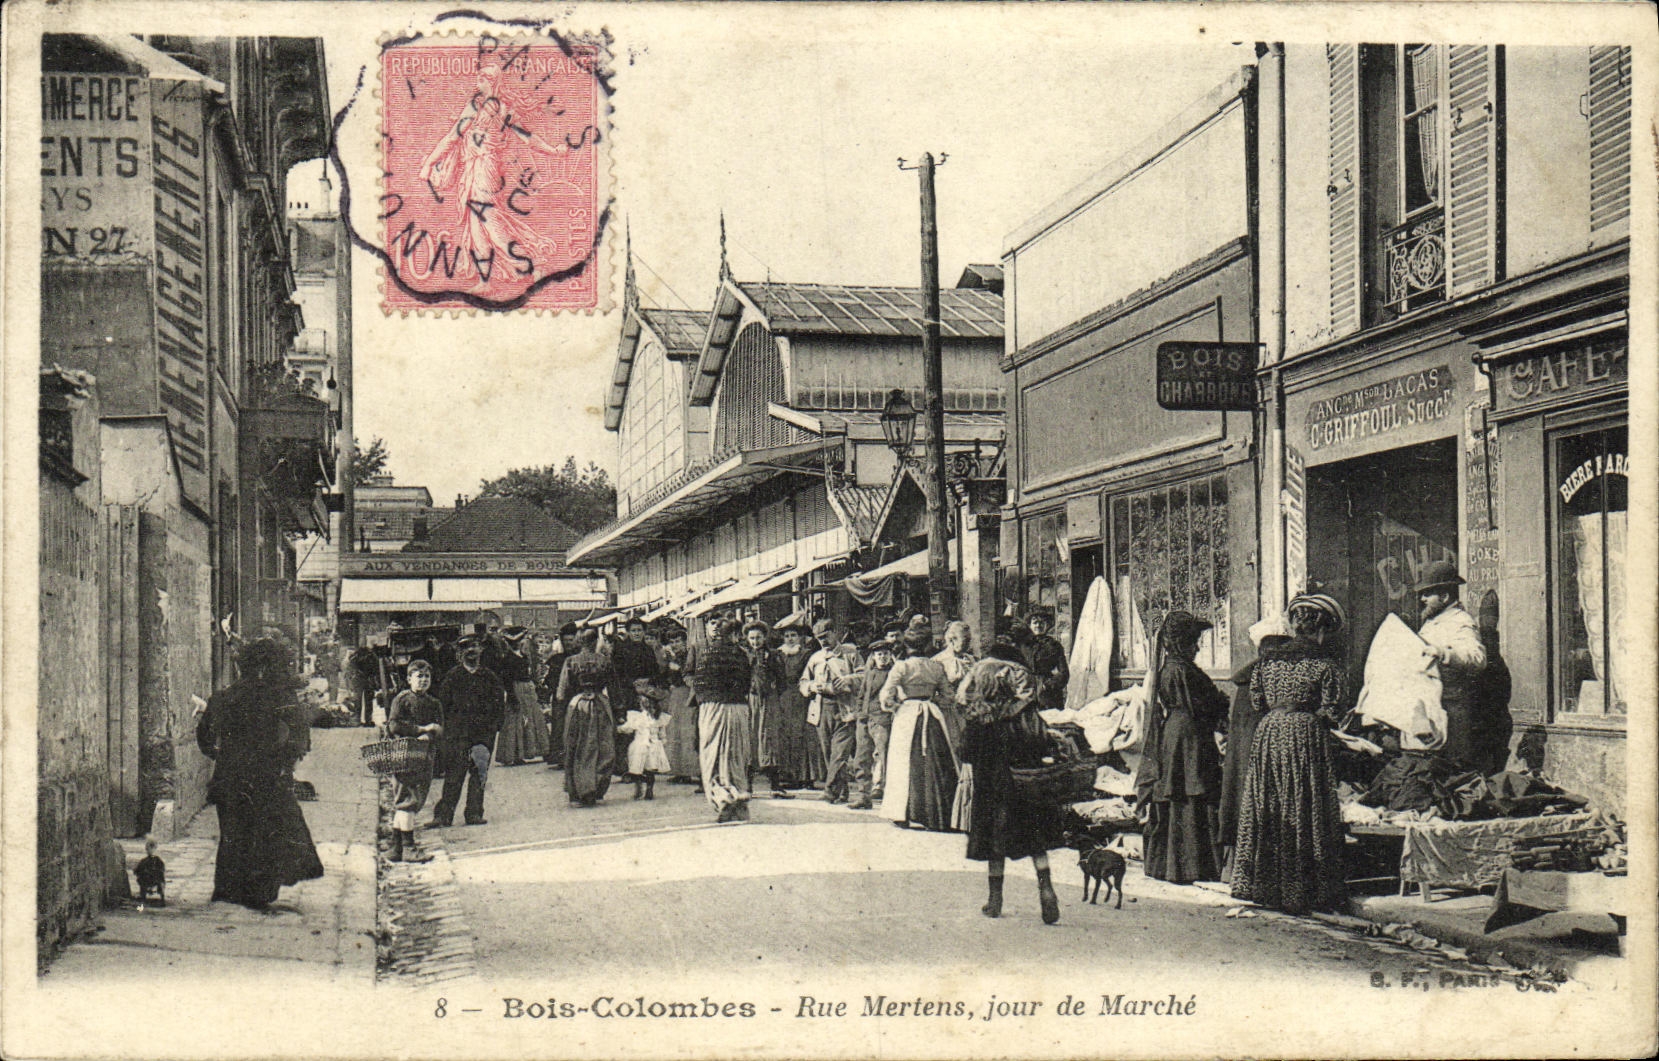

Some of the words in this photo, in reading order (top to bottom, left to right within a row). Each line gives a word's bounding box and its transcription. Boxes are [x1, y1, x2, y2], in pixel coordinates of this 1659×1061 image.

[41, 187, 92, 212] YS
[1167, 348, 1241, 371] BOIS
[1383, 368, 1439, 401] LACAS
[1560, 459, 1594, 503] BIERE
[365, 561, 393, 571] AUX
[499, 561, 515, 571] DE
[1470, 547, 1499, 564] COKE
